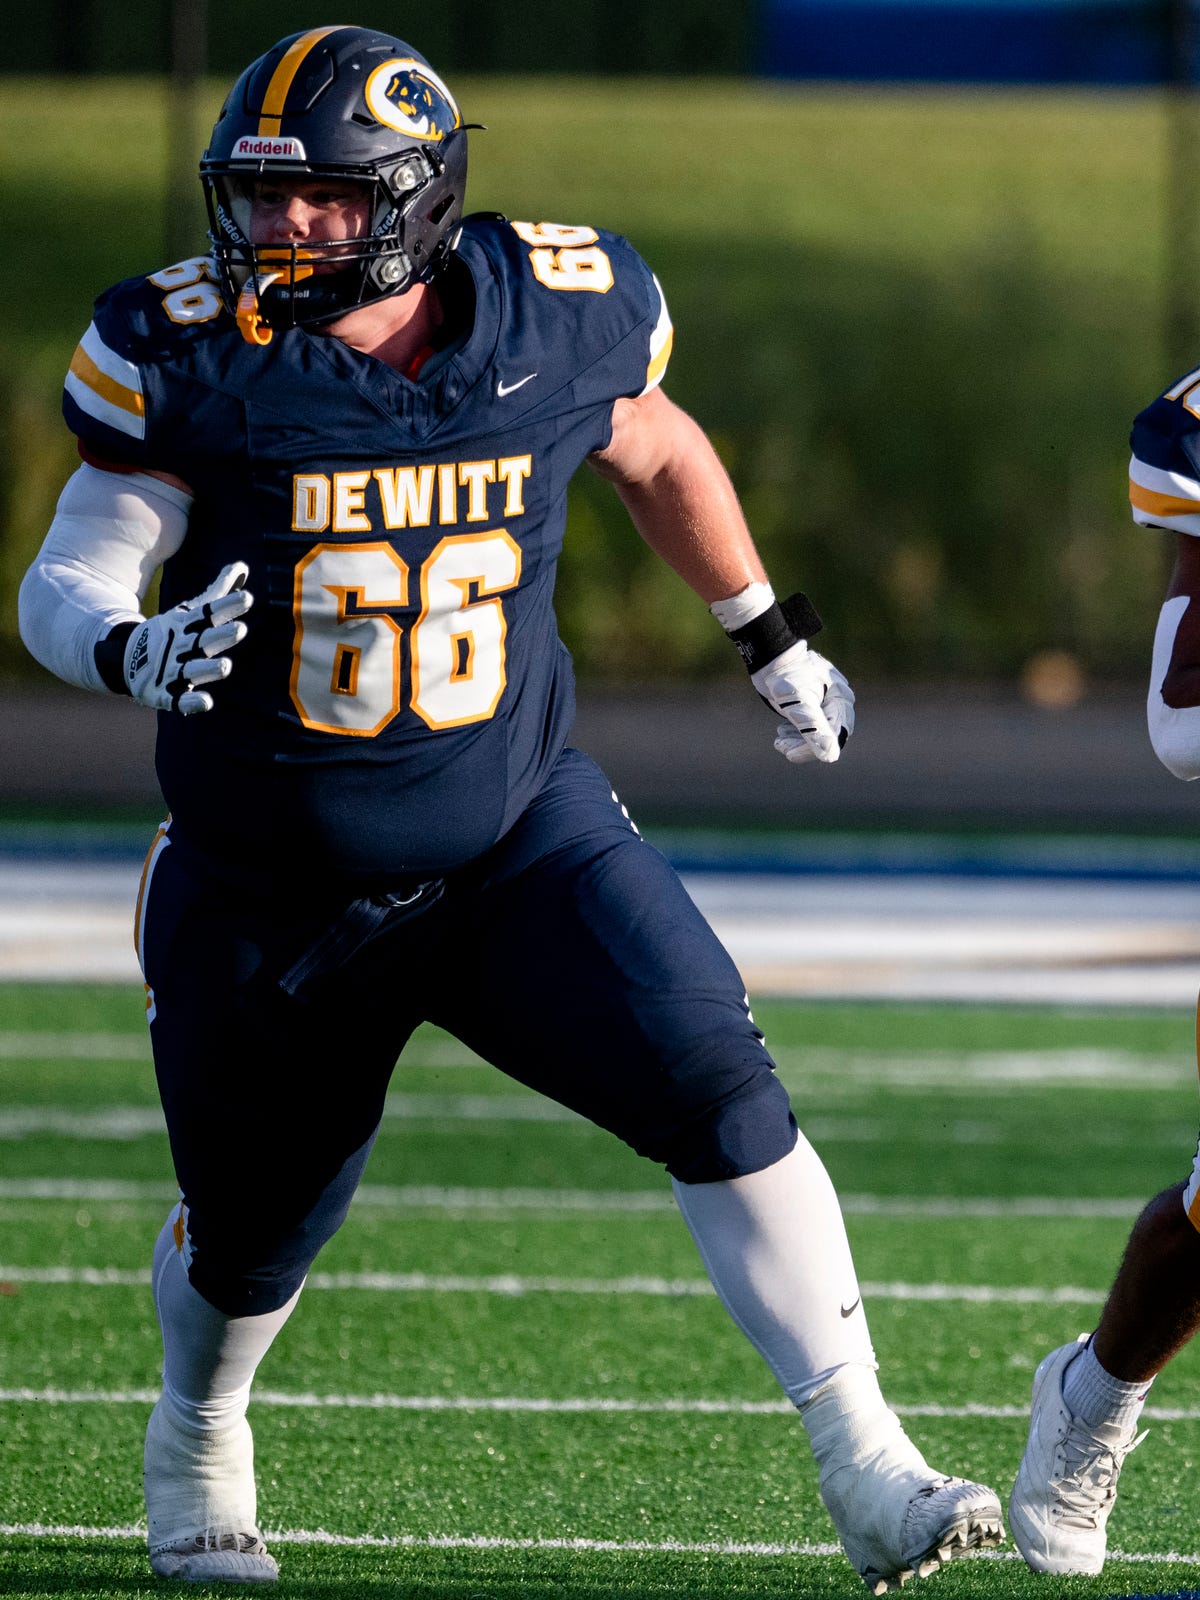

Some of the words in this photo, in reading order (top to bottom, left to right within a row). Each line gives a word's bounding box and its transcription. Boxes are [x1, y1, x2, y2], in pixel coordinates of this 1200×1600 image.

[239, 141, 293, 155] Riddell
[145, 256, 224, 325] 66
[509, 221, 615, 294] 66
[291, 454, 532, 533] DEWITT
[289, 528, 522, 738] 66
